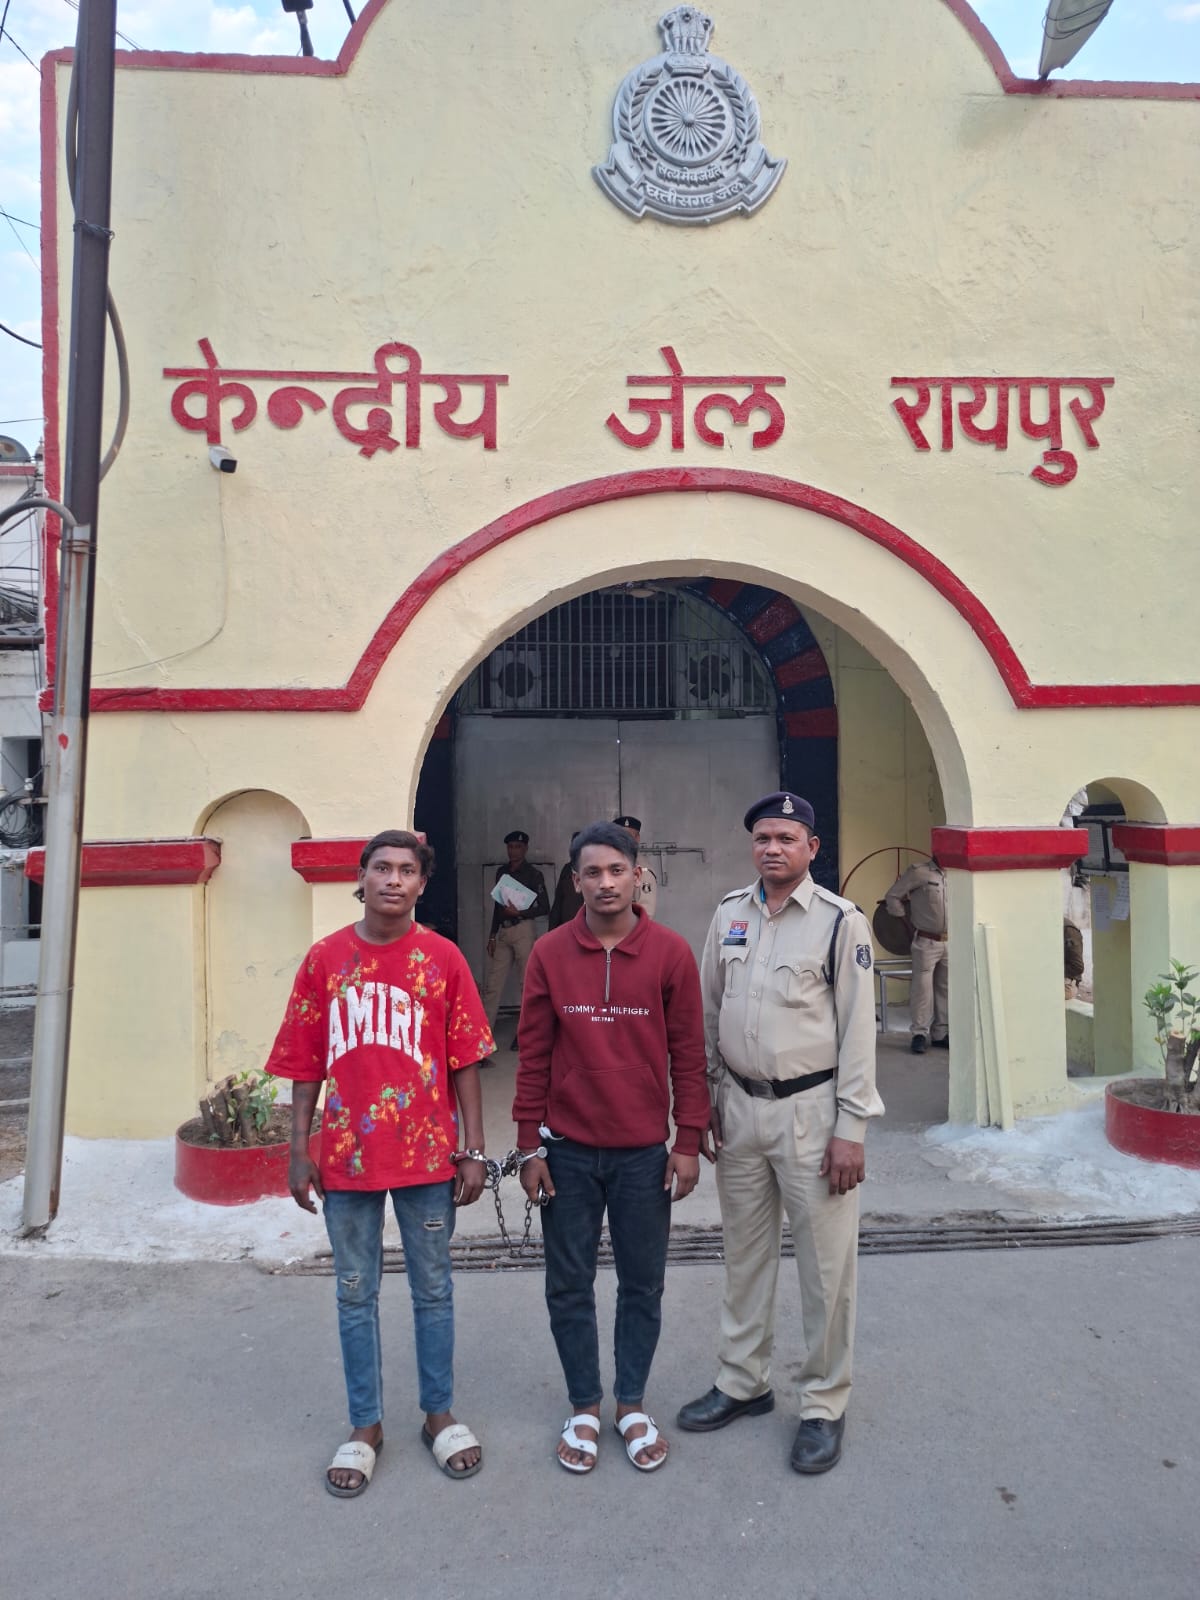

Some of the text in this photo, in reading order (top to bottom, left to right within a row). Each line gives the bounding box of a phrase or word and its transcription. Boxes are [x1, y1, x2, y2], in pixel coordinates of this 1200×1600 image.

[163, 337, 1115, 486] केन्द्रीय जेल रायपुर
[326, 981, 424, 1070] AMIRI
[563, 1005, 650, 1016] TOMMY HILFIGER
